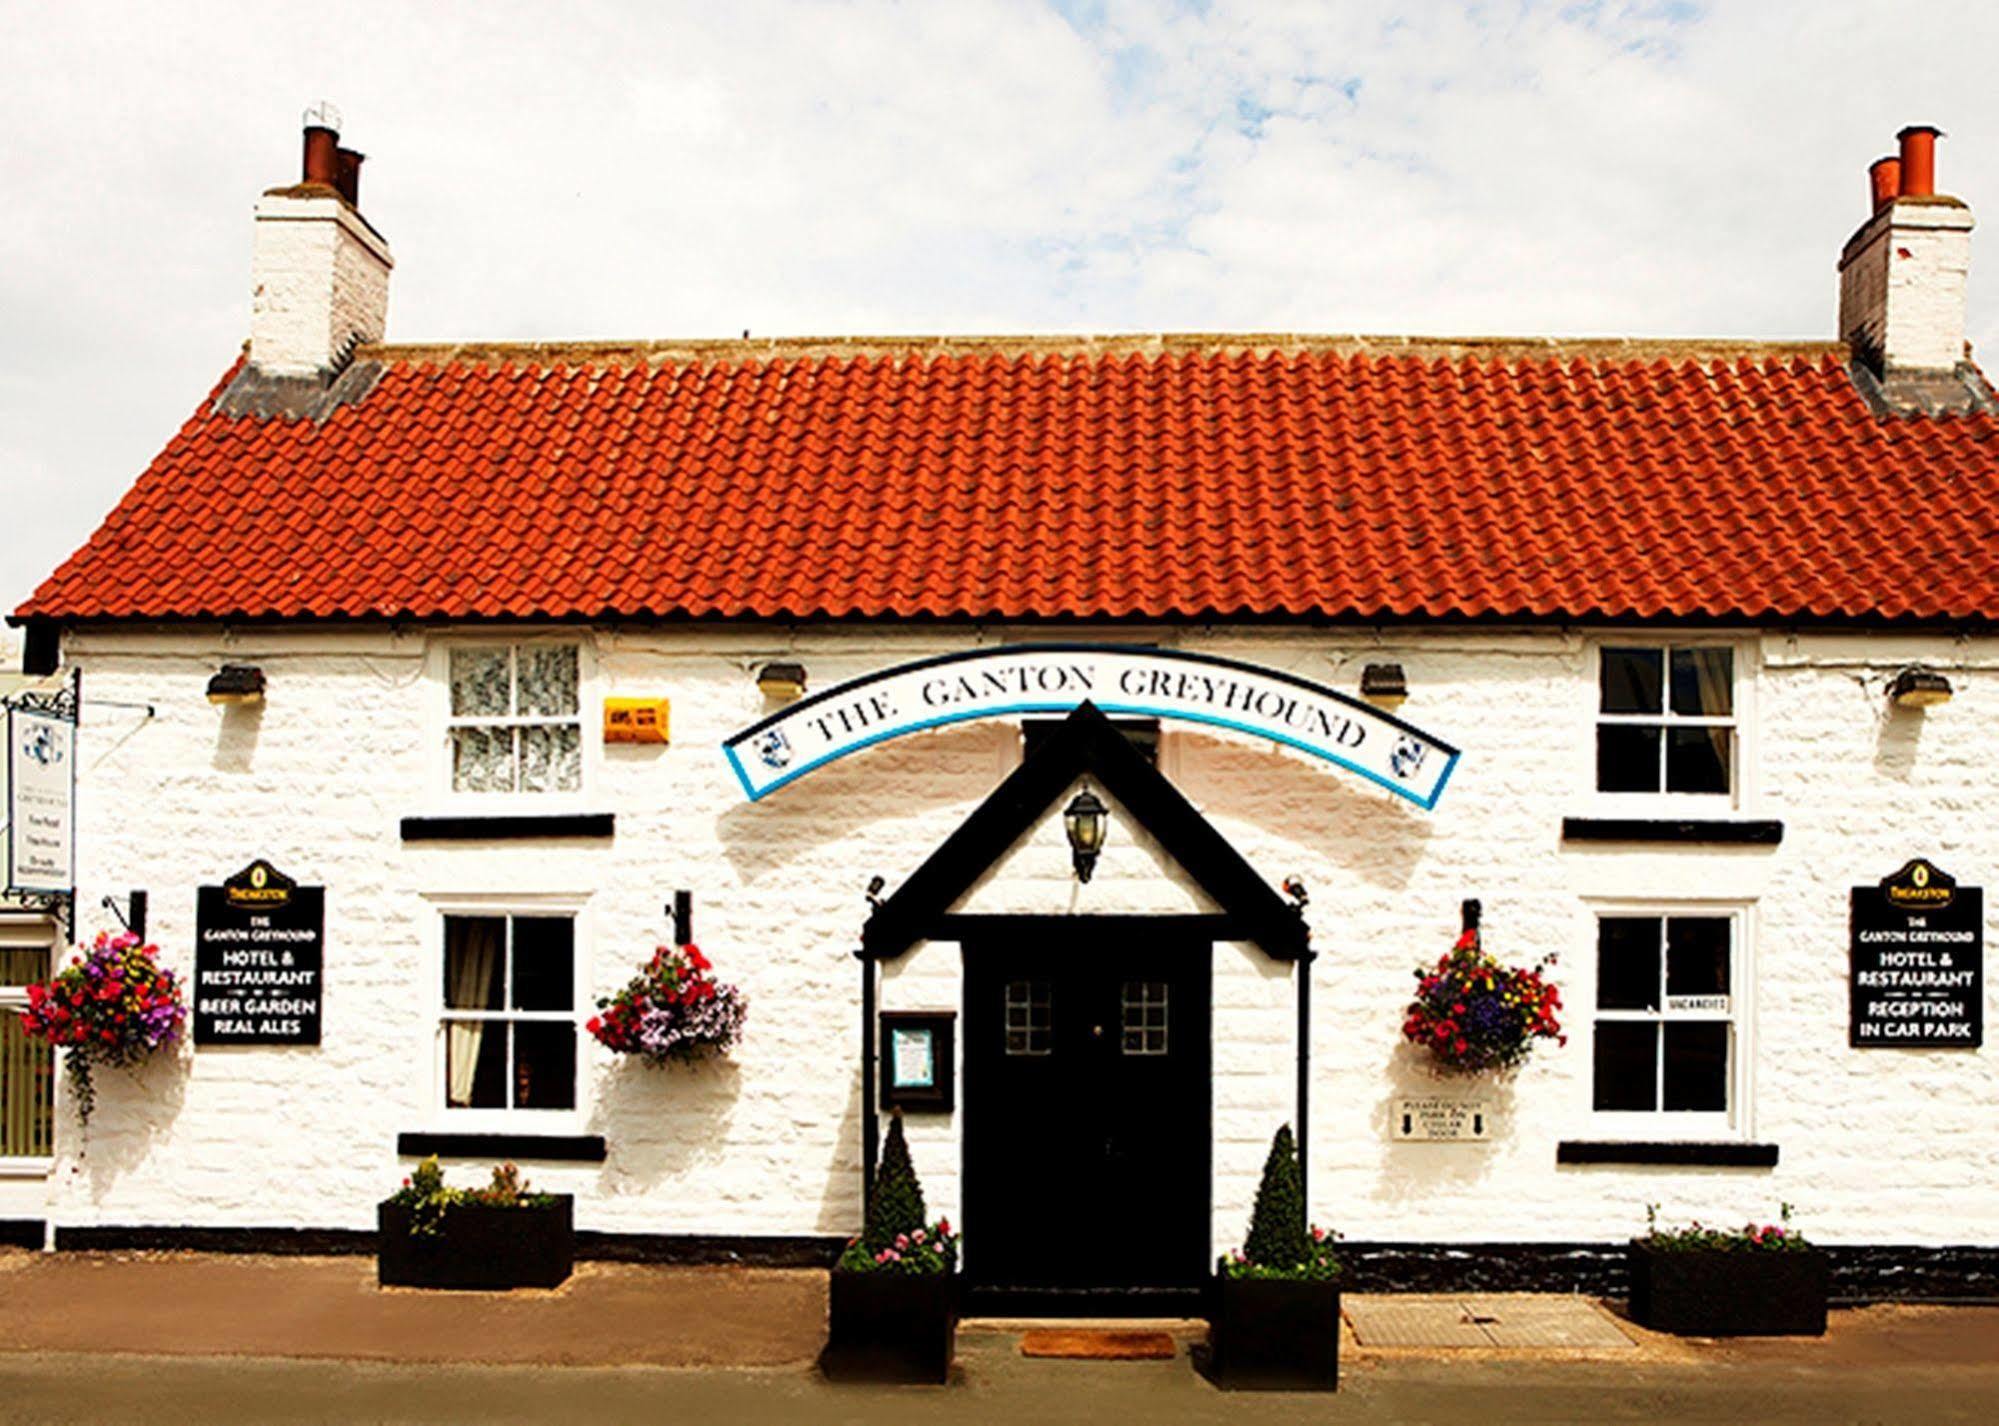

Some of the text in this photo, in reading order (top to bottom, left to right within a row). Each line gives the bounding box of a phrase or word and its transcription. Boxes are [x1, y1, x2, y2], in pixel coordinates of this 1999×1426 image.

[807, 665, 1367, 749] THE GANTON GREYHOUND
[250, 916, 270, 927] THE
[1907, 916, 1927, 927] THE
[203, 928, 316, 942] GANTON GREYHOUND
[1859, 930, 1975, 942] GANTON GREYHOUND
[223, 950, 294, 967] HOTEL &
[1880, 952, 1953, 967] HOTEL &
[201, 971, 316, 985] RESTAURANT
[1858, 971, 1974, 987] RESTAURANT
[199, 998, 317, 1015] BEER GARDEN
[1868, 1001, 1965, 1018] RECEPTION
[213, 1020, 301, 1035] REAL ALES
[1860, 1022, 1972, 1037] IN CAR PARK
